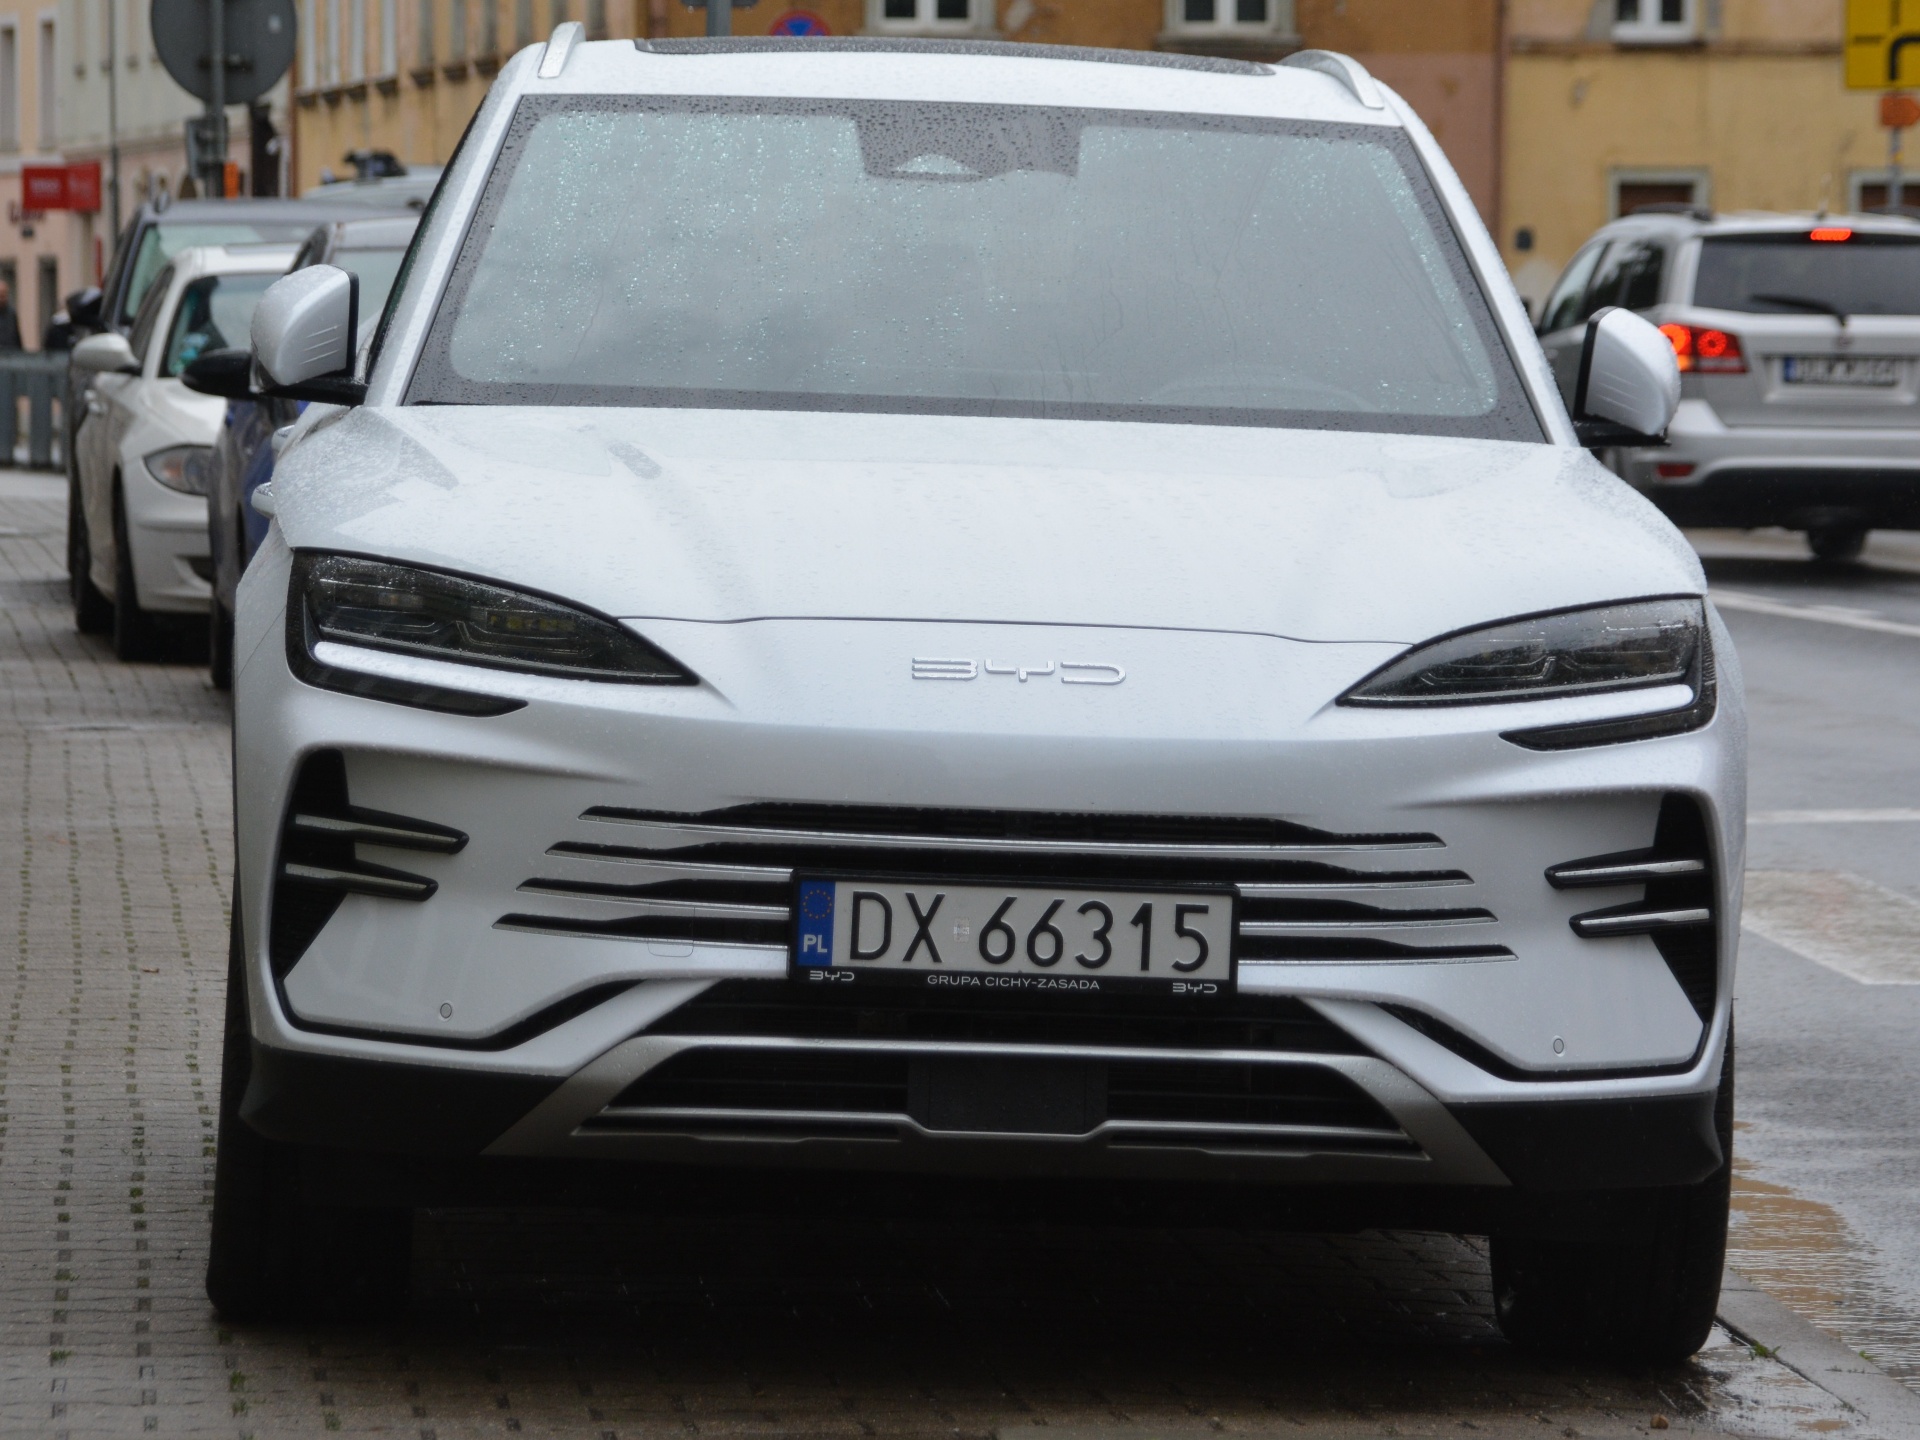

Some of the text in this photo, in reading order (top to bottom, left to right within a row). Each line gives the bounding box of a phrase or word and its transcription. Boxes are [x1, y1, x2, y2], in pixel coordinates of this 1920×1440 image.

[911, 657, 1126, 685] BYD
[849, 891, 1210, 972] DX 66315
[803, 934, 828, 953] PL
[810, 970, 855, 981] BYD
[927, 974, 1100, 990] GRUPA CICHY-ZASADA
[1172, 983, 1217, 994] BYD
